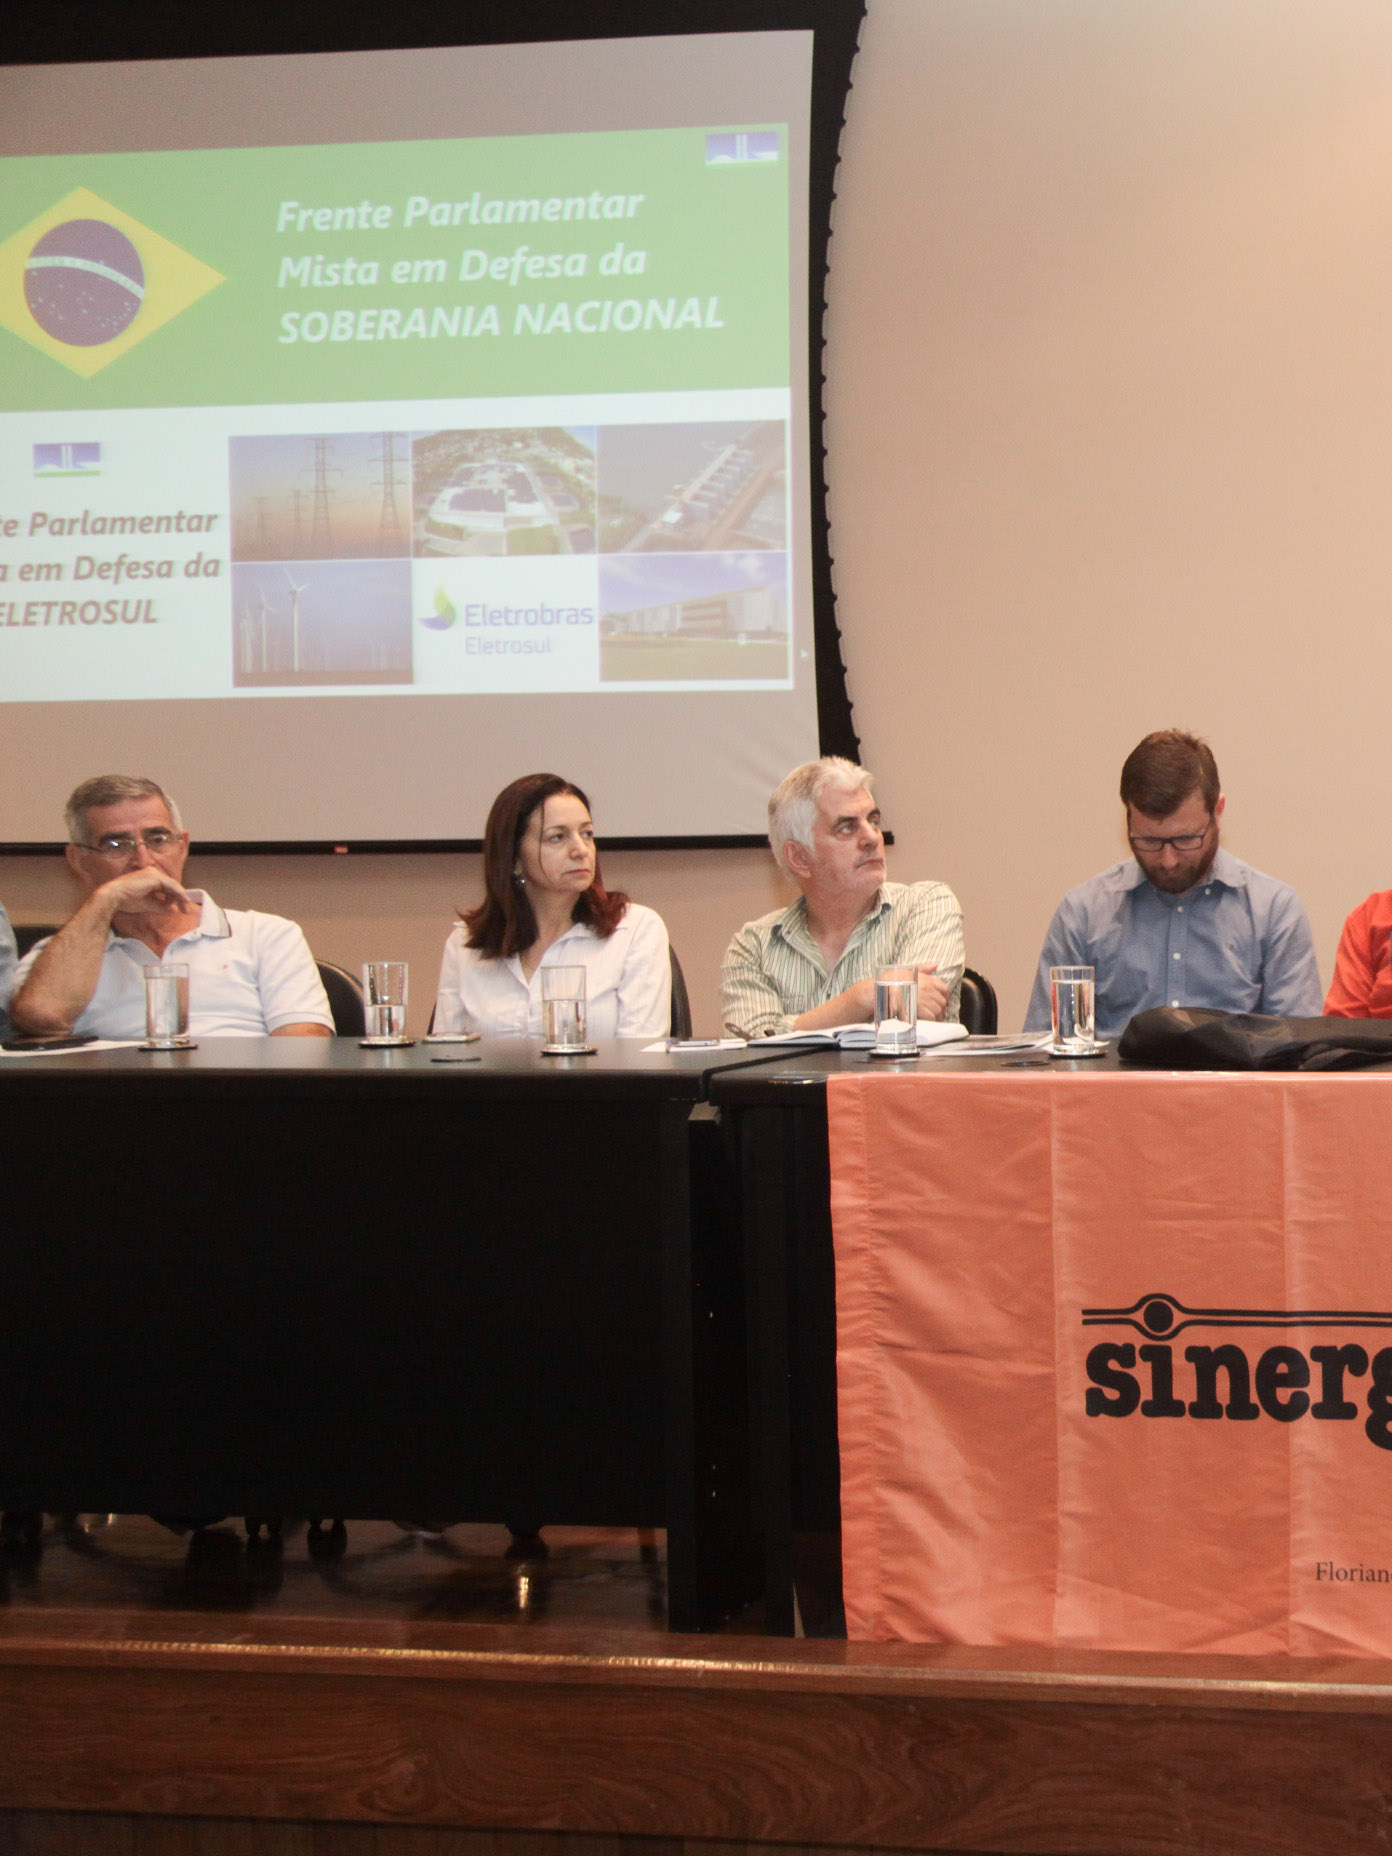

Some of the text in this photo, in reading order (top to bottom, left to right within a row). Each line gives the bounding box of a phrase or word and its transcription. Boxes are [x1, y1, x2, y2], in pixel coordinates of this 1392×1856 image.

[276, 192, 645, 233] Frente Parlamentar
[278, 242, 646, 288] Mista em Defesa da
[278, 296, 724, 344] SOBERANIA NACIONAL
[29, 509, 218, 536] Parlamentar
[18, 562, 63, 581] em
[73, 553, 174, 585] Defesa
[184, 552, 220, 578] da
[464, 603, 594, 627] Eletrobras
[464, 635, 552, 655] Eletrosul
